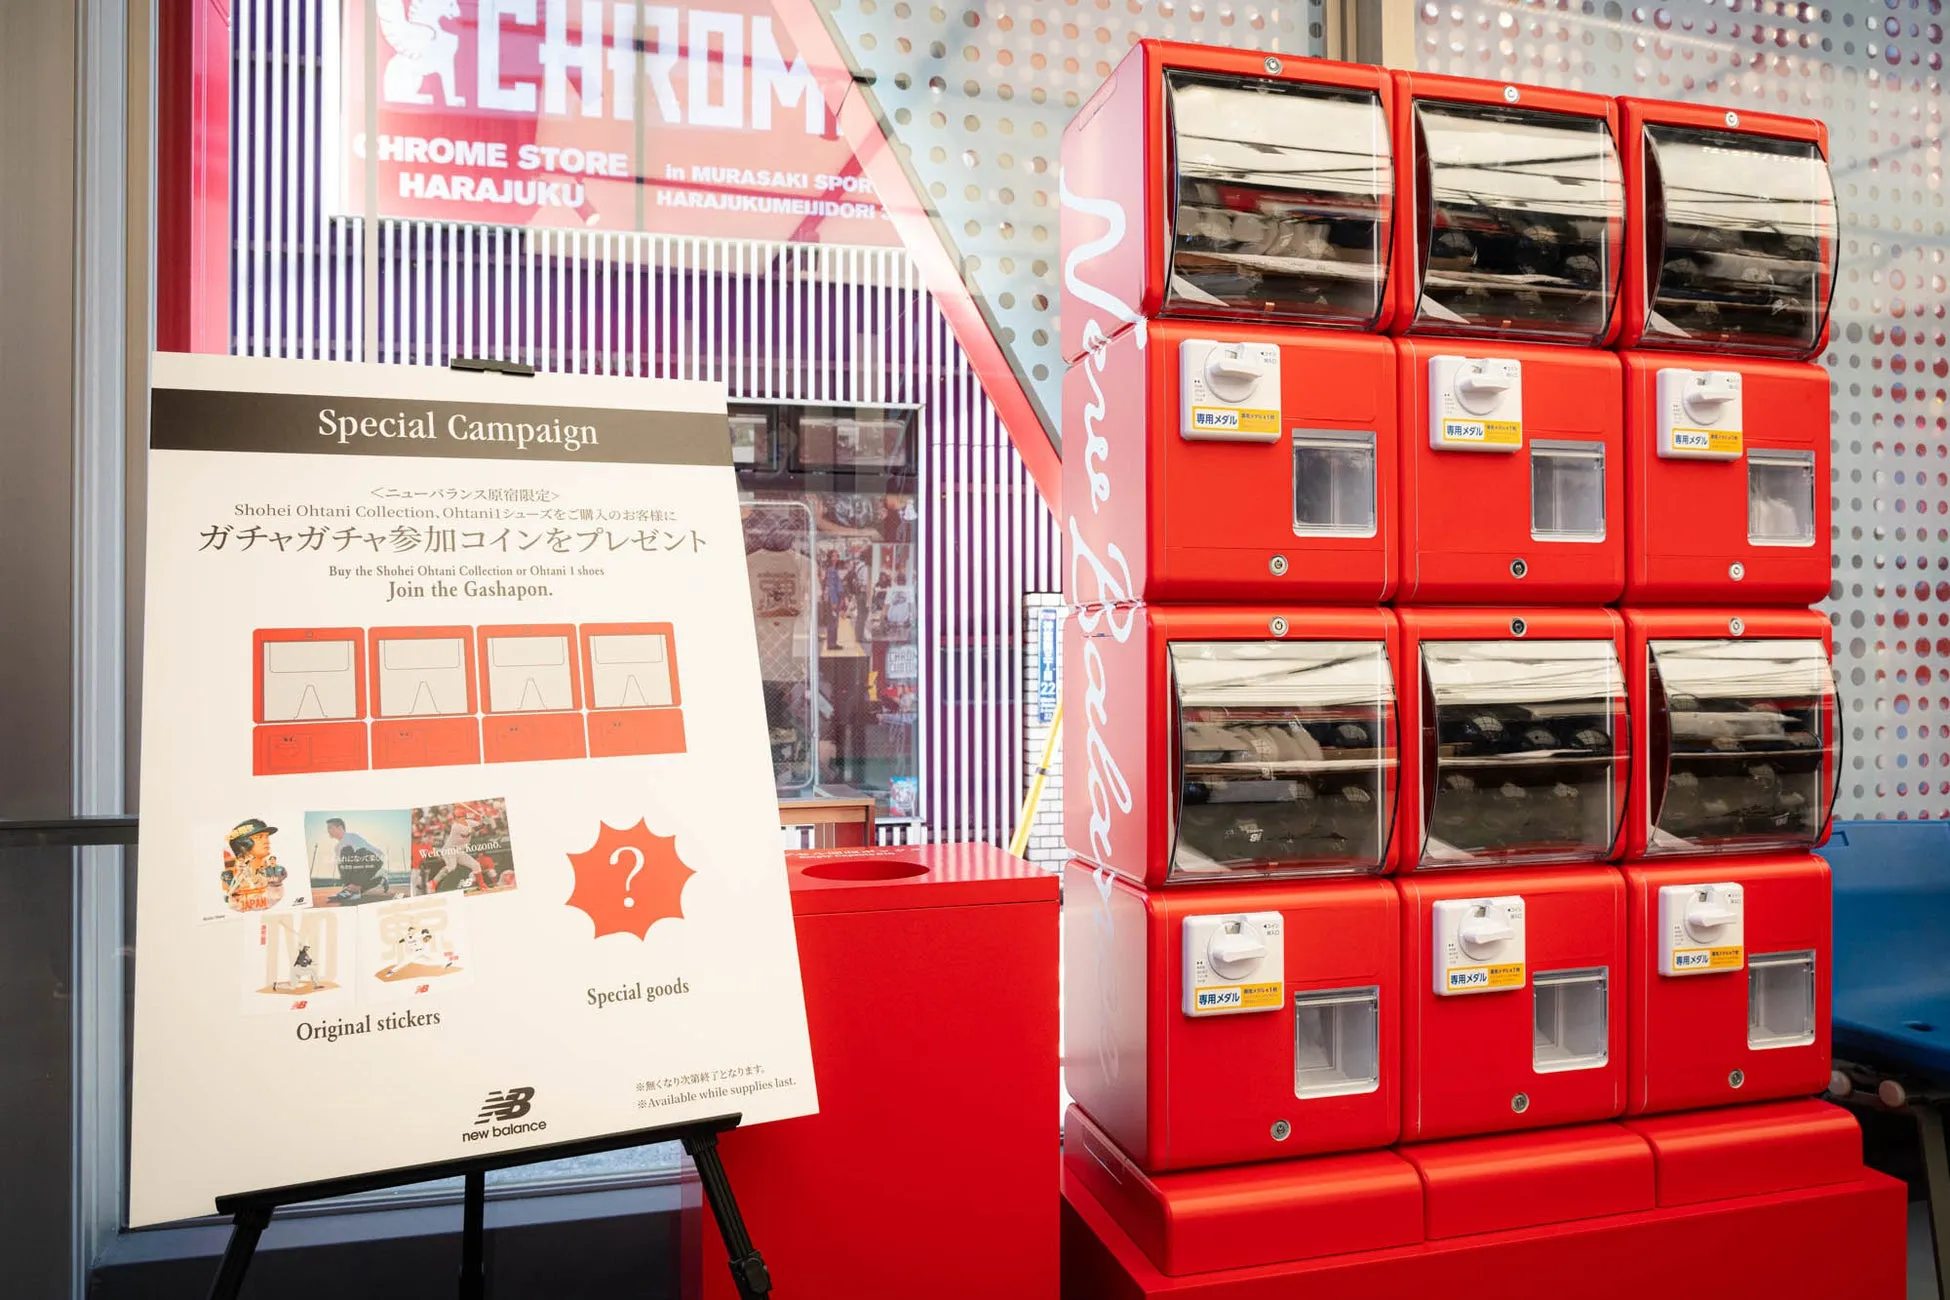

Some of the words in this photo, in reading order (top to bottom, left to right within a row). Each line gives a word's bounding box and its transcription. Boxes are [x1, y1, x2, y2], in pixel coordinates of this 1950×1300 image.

[477, 0, 844, 135] CHROM
[517, 144, 629, 177] STORE
[399, 172, 585, 207] HARAJUKU
[665, 164, 686, 182] in
[691, 166, 808, 189] MURASAKI
[813, 175, 873, 193] SPOR
[656, 190, 876, 220] HARAJUKUMEIJIDORI
[318, 408, 437, 444] Special
[448, 413, 599, 451] Campaign
[1196, 413, 1238, 425] 専用メダル
[1446, 425, 1484, 436] 専用メダル
[1675, 434, 1708, 446] 専用メダル
[234, 503, 291, 517] Shohei
[296, 505, 351, 518] Ohtani
[198, 525, 707, 553] ガチャガチャ参加コインをプレゼント
[328, 565, 352, 579] Buy
[355, 566, 373, 577] the
[376, 565, 414, 577] Shohei
[417, 565, 456, 577] Ohtani
[459, 565, 513, 577] Collection
[516, 568, 527, 577] or
[529, 565, 567, 577] Ohtani
[570, 566, 574, 576] 1
[577, 565, 605, 577] shoes
[386, 580, 425, 602] Join
[431, 580, 458, 598] the
[464, 579, 553, 601] Gashapon.
[1041, 682, 1056, 695] 22
[242, 898, 267, 911] JAPAN
[1676, 954, 1709, 966] 専用メダル
[1450, 973, 1487, 985] 専用メダル
[587, 982, 642, 1009] Special
[646, 977, 690, 1002] goods
[1199, 992, 1240, 1005] 専用メダル
[296, 1014, 371, 1042] Original
[376, 1009, 441, 1034] stickers
[699, 1086, 729, 1101] while
[730, 1079, 773, 1096] supplies
[774, 1076, 797, 1089] last.
[462, 1128, 490, 1143] new
[492, 1119, 547, 1140] balance
